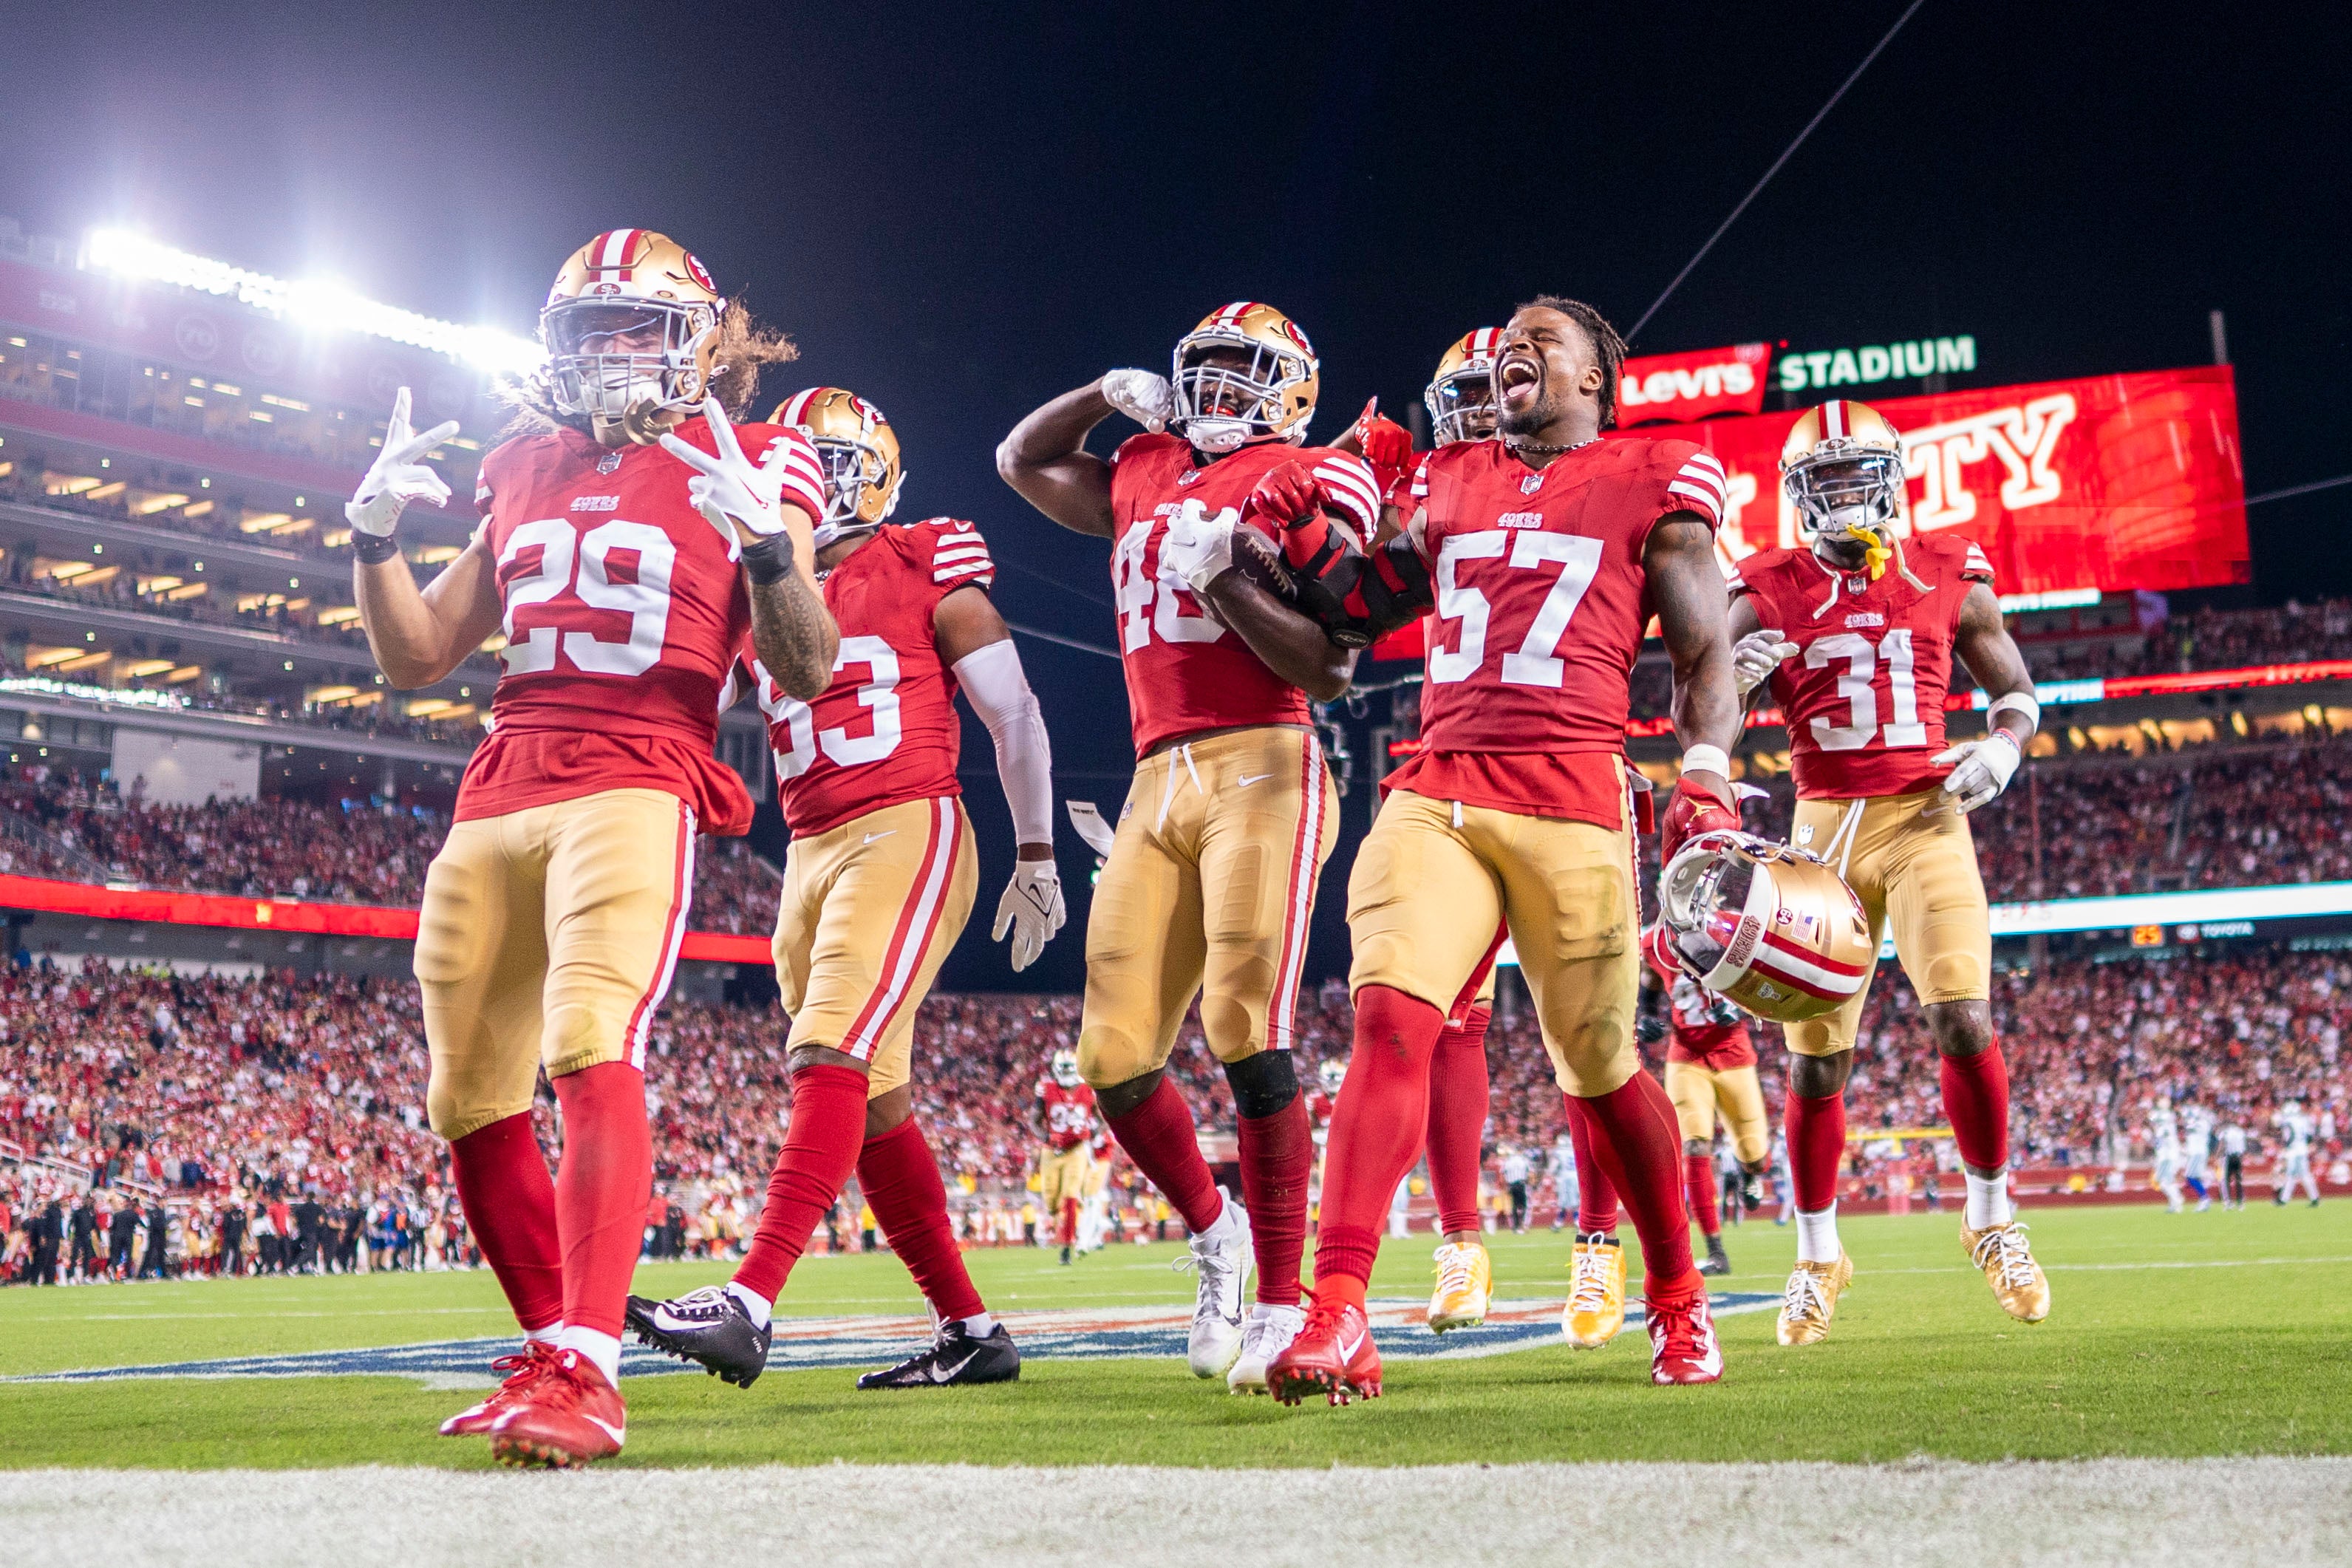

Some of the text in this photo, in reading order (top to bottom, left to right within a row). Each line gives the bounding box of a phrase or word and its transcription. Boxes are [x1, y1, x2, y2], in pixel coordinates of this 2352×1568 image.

[1779, 335, 1976, 392] STADIUM
[570, 496, 620, 511] 49ERS
[1153, 503, 1184, 517] 49ER
[1497, 512, 1543, 528] 49ERS
[497, 518, 676, 676] 29
[1429, 530, 1604, 688] 57
[1844, 613, 1884, 628] 49ERS
[1804, 629, 1927, 751] 31
[1726, 915, 1760, 968] 49ERS
[2200, 922, 2256, 938] TOYOTA
